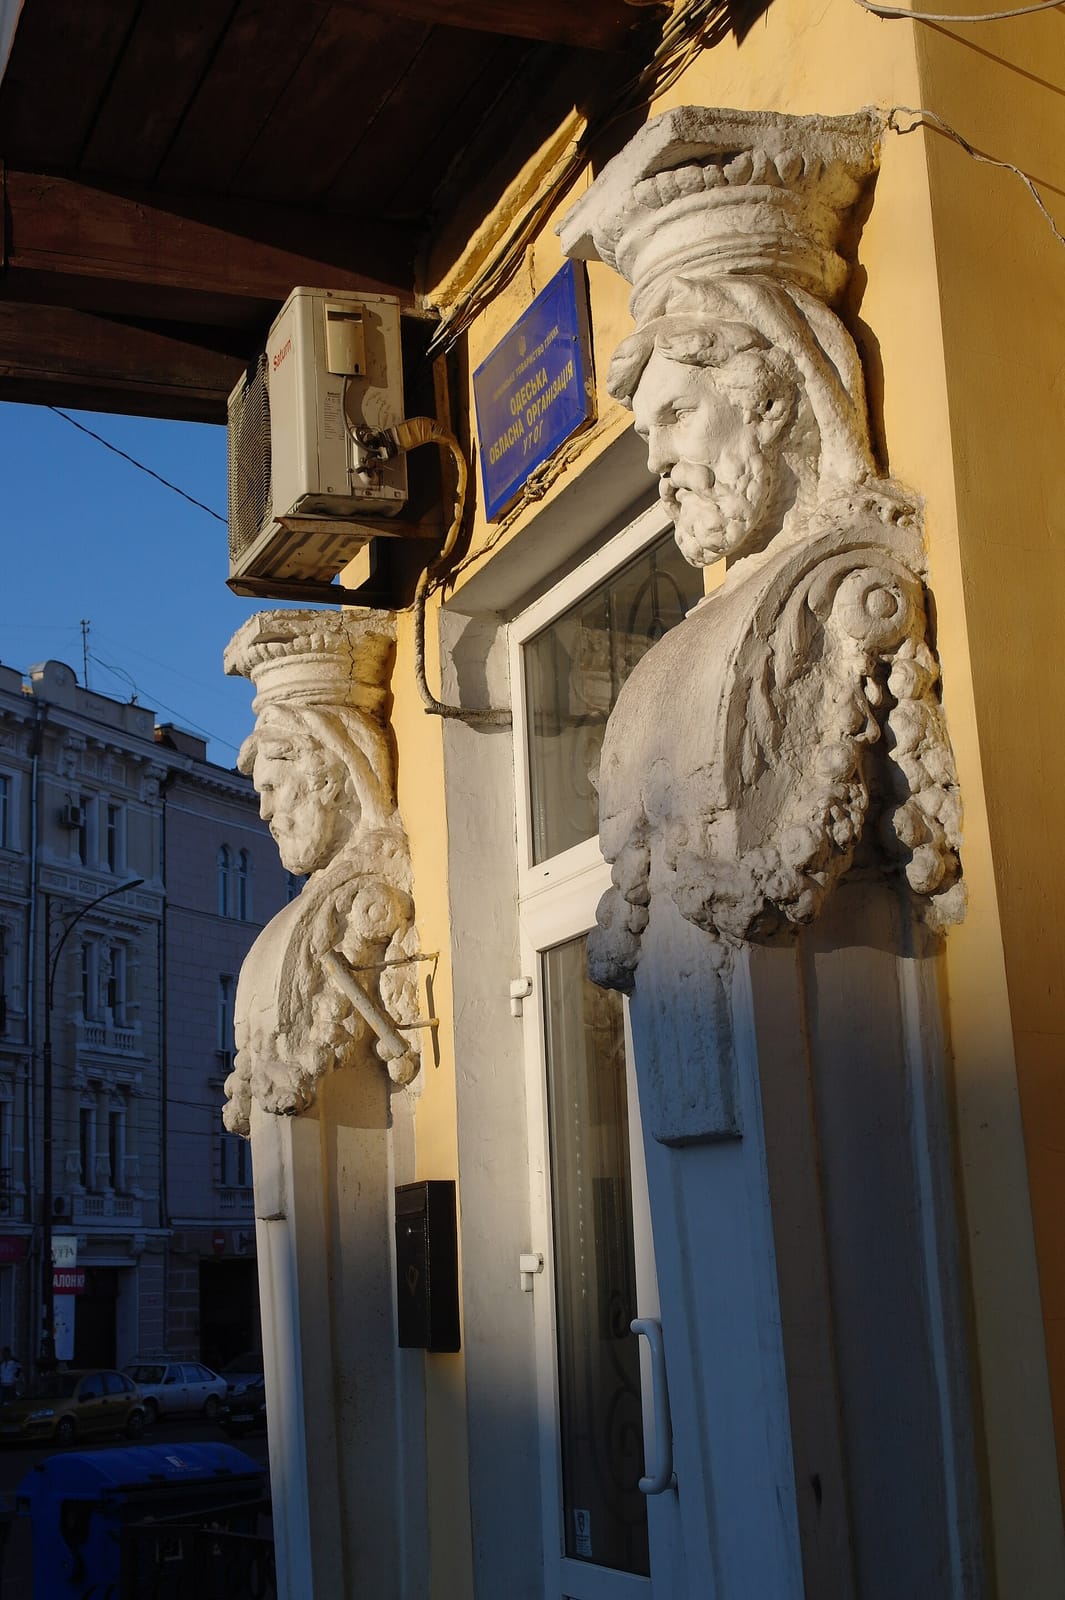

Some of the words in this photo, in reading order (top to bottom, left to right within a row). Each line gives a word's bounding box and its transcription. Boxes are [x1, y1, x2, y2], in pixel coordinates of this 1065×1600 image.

[489, 418, 525, 465] ОБЛАСНА
[526, 359, 574, 427] ОРГАНІЗАЦІЯ
[510, 368, 548, 416] ОДЕСЬКА
[523, 420, 544, 457] УТОГ
[53, 1273, 76, 1288] АЛОН
